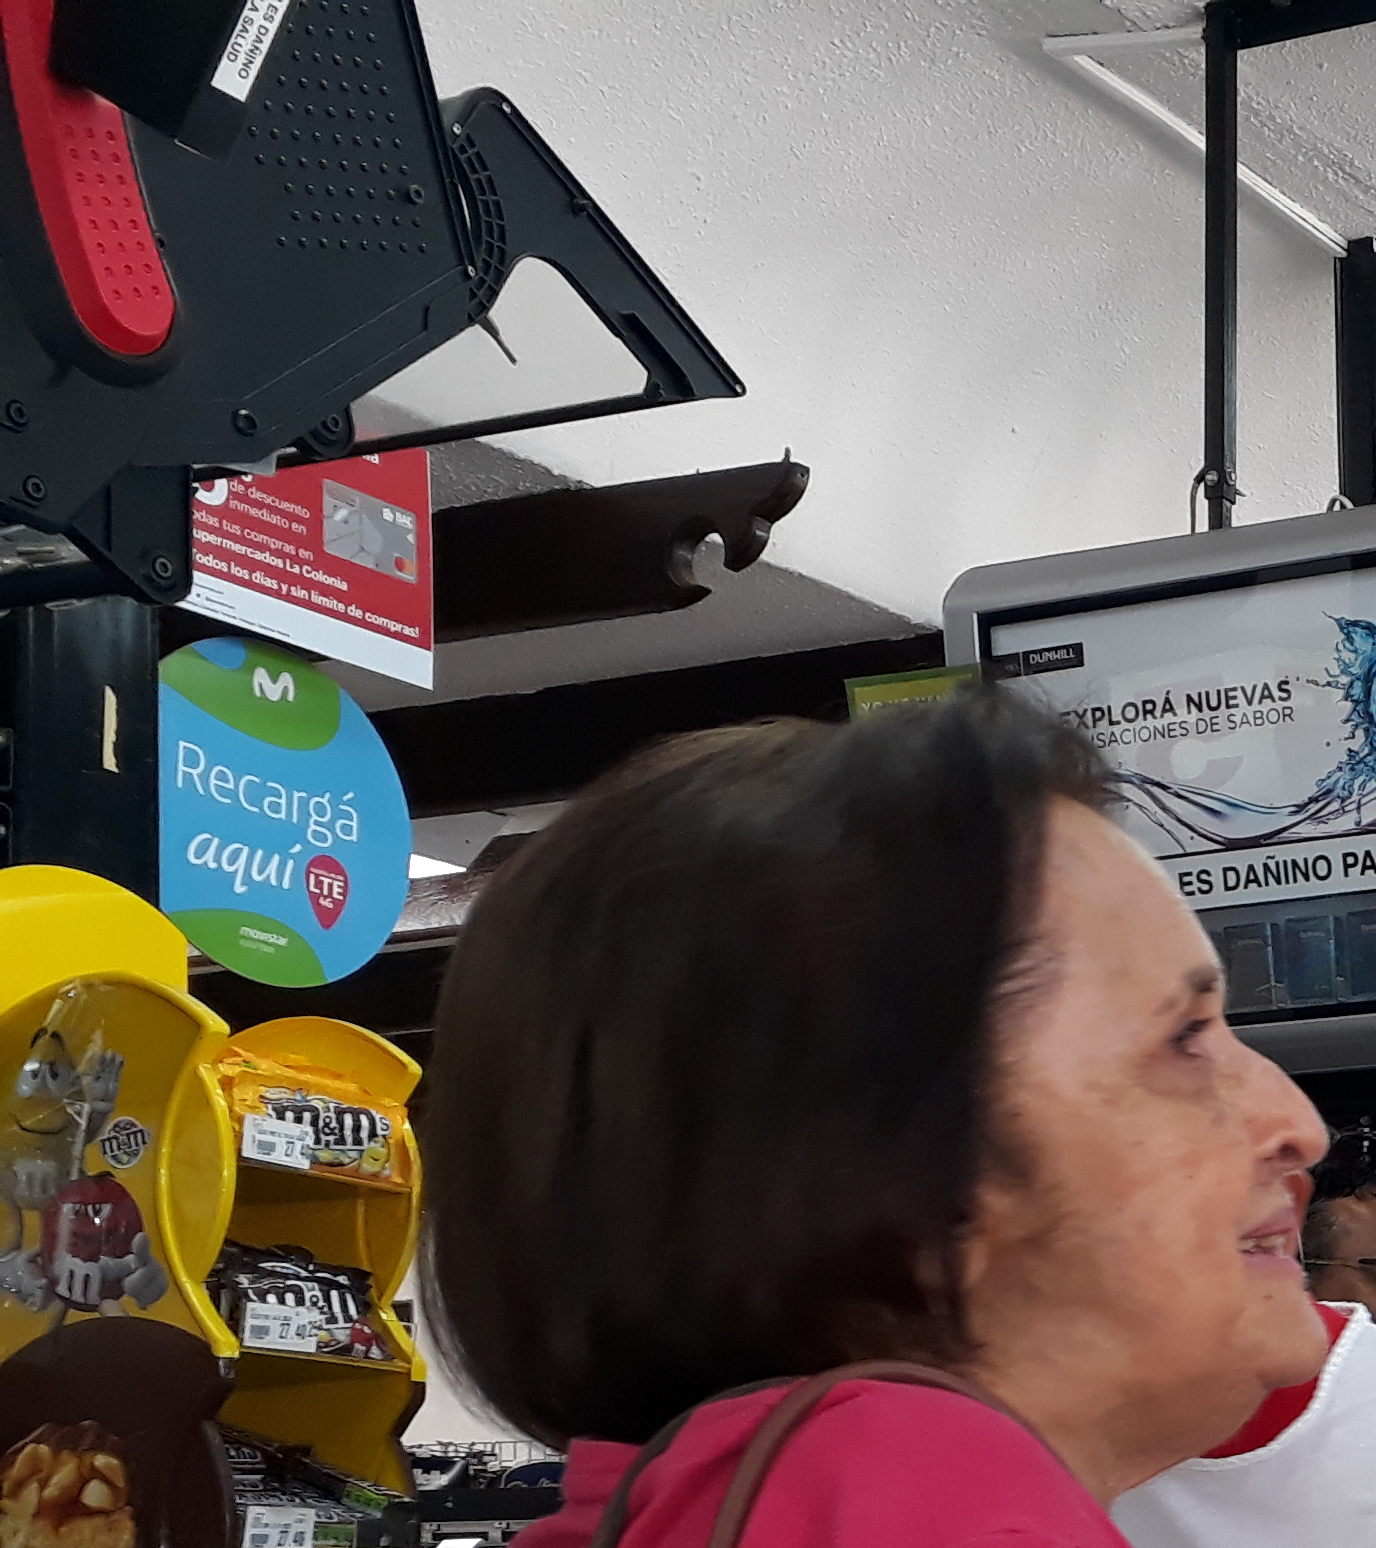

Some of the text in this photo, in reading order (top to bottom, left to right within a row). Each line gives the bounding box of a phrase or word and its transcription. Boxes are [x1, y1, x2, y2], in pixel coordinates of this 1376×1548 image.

[226, 15, 254, 63] SALUD
[244, 525, 296, 556] compras
[298, 547, 314, 562] en
[292, 521, 307, 535] en
[193, 528, 349, 592] upermercados La Colonia
[230, 562, 250, 580] los
[290, 585, 309, 601] sin
[347, 599, 363, 619] de
[365, 611, 420, 638] compras!
[1185, 676, 1293, 714] NUEVAS
[1091, 705, 1295, 749] SACIONES DE SABOR
[176, 740, 359, 848] Recargá
[187, 833, 303, 894] aquí
[1178, 868, 1214, 897] ES
[1222, 853, 1333, 893] DAÑINO
[308, 872, 345, 901] LTE
